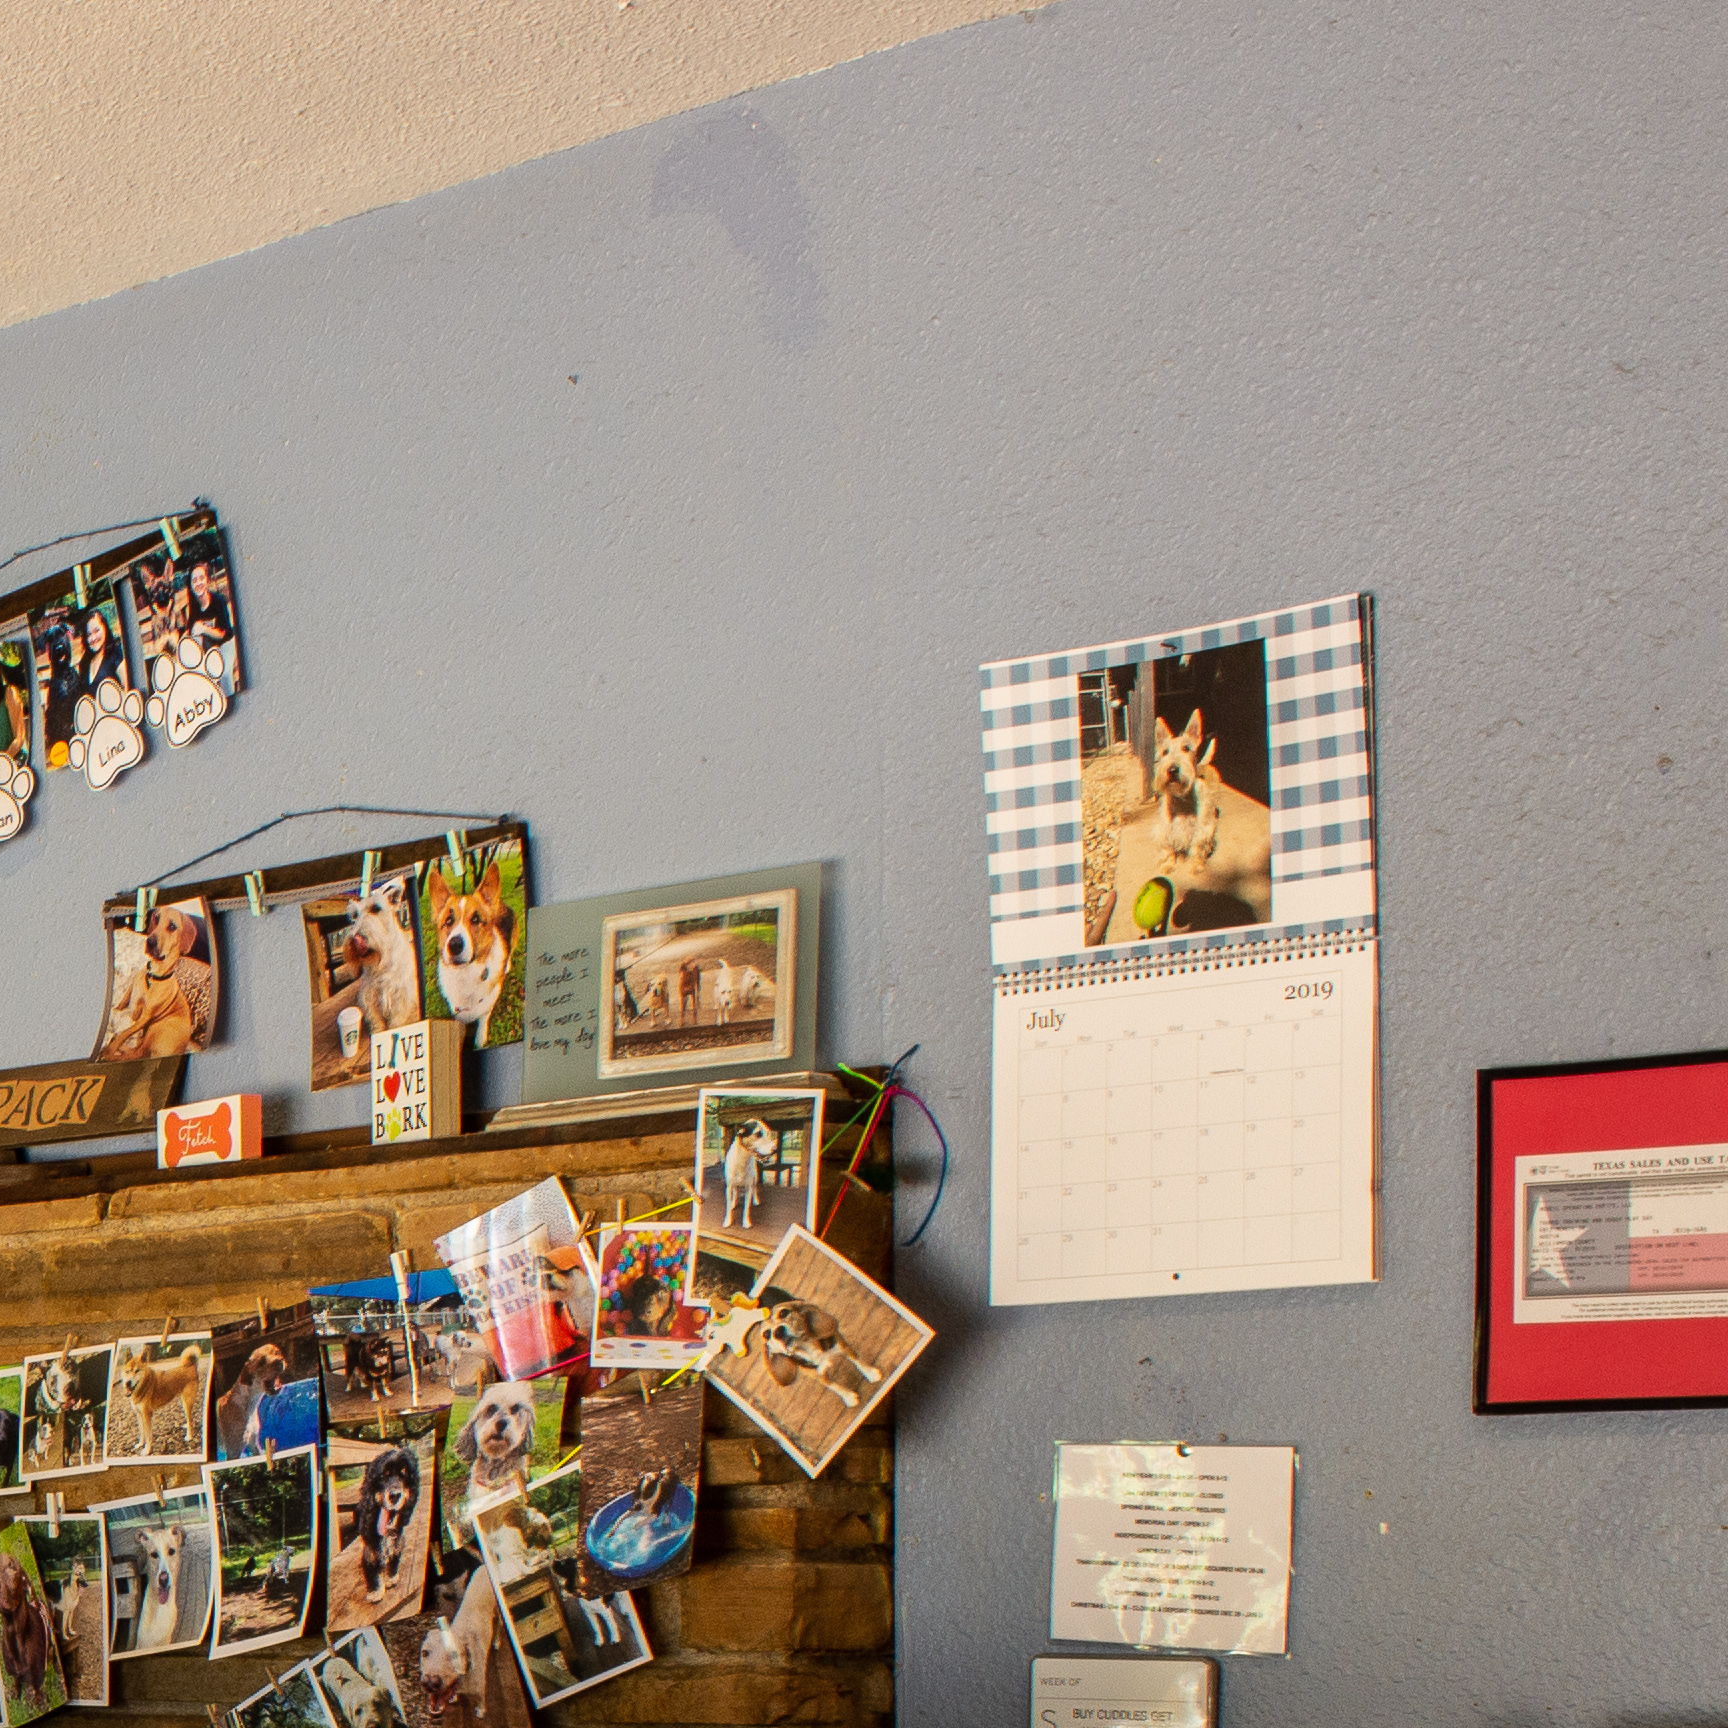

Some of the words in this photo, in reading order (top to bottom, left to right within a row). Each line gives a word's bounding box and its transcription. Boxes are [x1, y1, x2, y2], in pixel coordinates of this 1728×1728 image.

[174, 693, 214, 733] Abby
[98, 739, 126, 767] Lina
[537, 953, 556, 967] The
[561, 948, 589, 961] more
[535, 967, 574, 993] people
[1026, 1008, 1066, 1032] July
[1284, 980, 1334, 1000] 2019
[529, 1016, 548, 1031] The
[554, 1012, 582, 1025] more
[178, 1120, 216, 1155] Fetch
[1593, 1161, 1626, 1170] TEXAS
[1629, 1159, 1661, 1168] SALES
[1667, 1157, 1689, 1166] AND
[1695, 1156, 1714, 1164] USE
[1040, 1678, 1066, 1686] WEEK
[1068, 1678, 1082, 1686] OF
[1073, 1709, 1094, 1719] BUY
[1096, 1709, 1147, 1721] CUDDLES
[1151, 1711, 1173, 1721] GET
